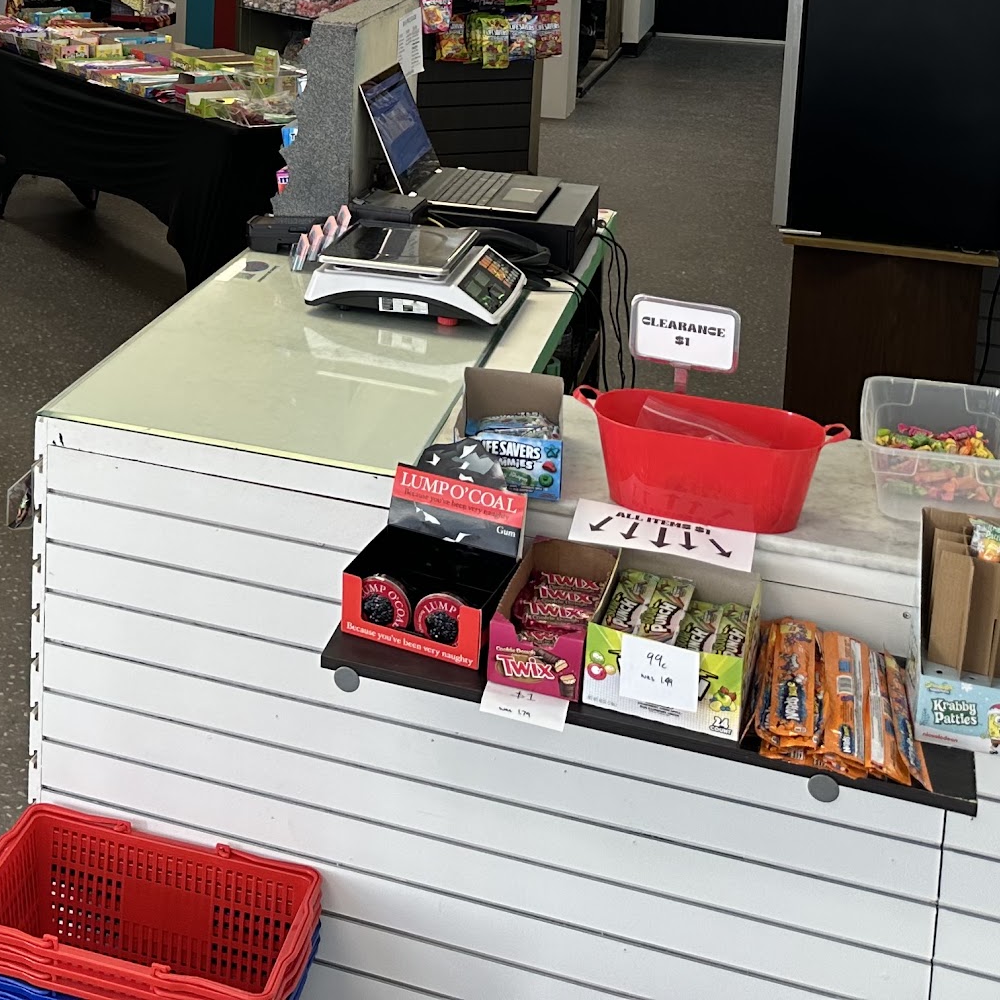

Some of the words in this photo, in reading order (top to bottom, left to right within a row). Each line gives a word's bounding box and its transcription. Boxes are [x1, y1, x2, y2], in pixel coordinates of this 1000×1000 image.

[641, 316, 726, 338] CLEARANCE
[674, 335, 690, 347] $1
[500, 440, 541, 460] SAVERS
[400, 472, 450, 495] LUMP
[450, 484, 518, 514] O'COAL
[404, 488, 430, 501] Because
[450, 499, 468, 510] been
[496, 525, 517, 539] Gum
[615, 511, 644, 522] ALL
[646, 516, 692, 531] ITEMS
[695, 524, 711, 536] $1
[423, 601, 457, 615] LUMP
[612, 597, 640, 627] PUNCH
[650, 600, 678, 633] PUNCH
[346, 621, 377, 638] Because
[377, 631, 402, 645] you've
[403, 639, 422, 651] been
[422, 644, 441, 657] very
[441, 650, 474, 666] naughty
[688, 626, 710, 652] UNCH
[495, 645, 516, 653] Cookie
[516, 647, 536, 655] Dough
[932, 699, 977, 716] Krabby
[713, 716, 730, 729] 24
[933, 711, 978, 726] Patties
[709, 725, 733, 736] COUNT
